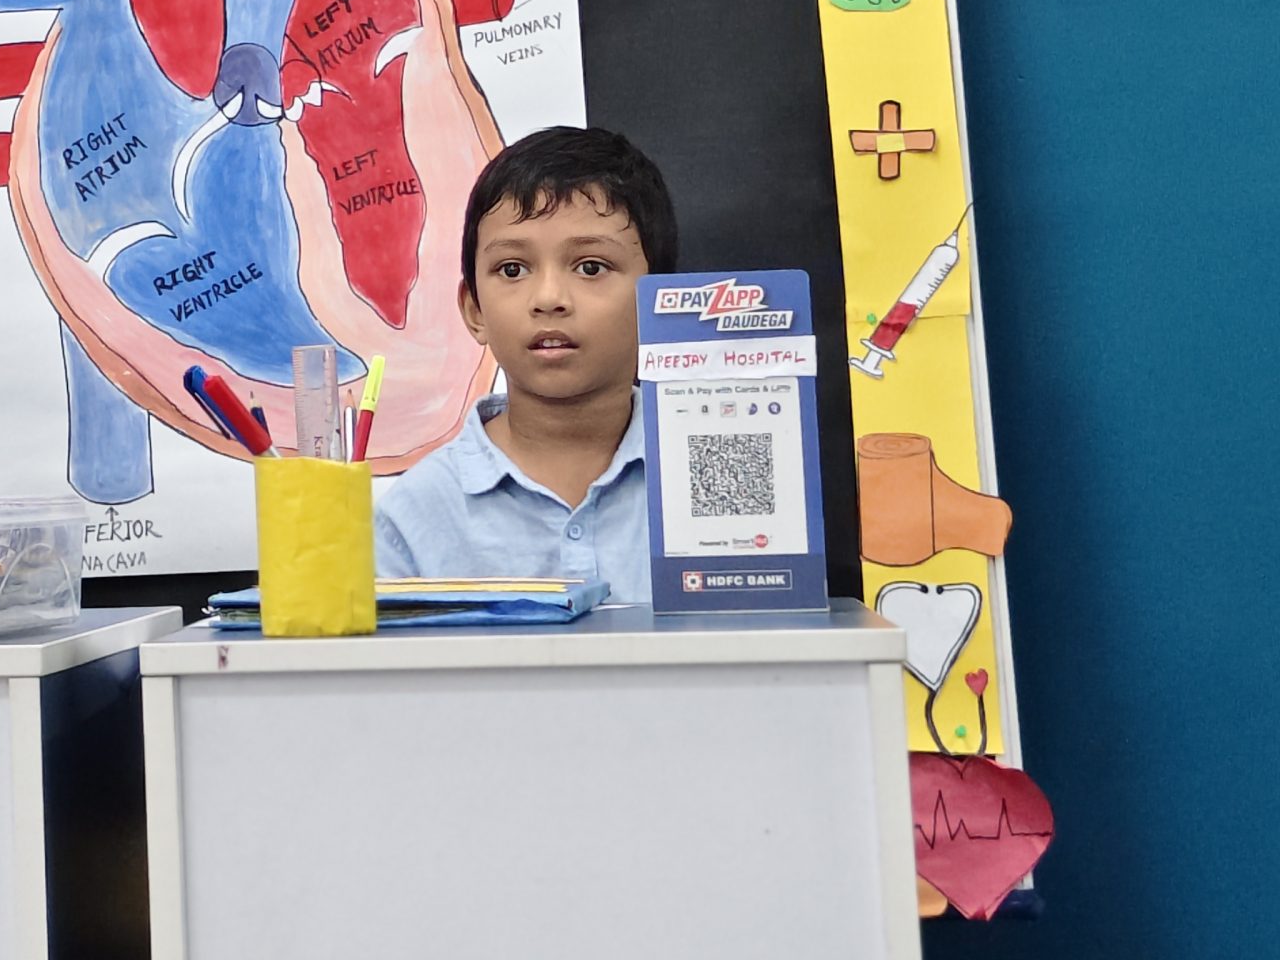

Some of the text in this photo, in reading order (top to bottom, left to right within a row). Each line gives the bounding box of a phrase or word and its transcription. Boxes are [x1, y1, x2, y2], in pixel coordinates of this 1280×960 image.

[317, 17, 382, 75] ATRIUM
[474, 12, 561, 48] PULMONARY
[497, 44, 543, 65] VEINS
[63, 112, 127, 170] RIGHT
[74, 135, 148, 202] ATRIUM
[333, 149, 378, 180] LEFT
[338, 178, 420, 215] VENTRICLE
[153, 251, 216, 296] RIGHT
[169, 262, 263, 322] VENTRICLE
[722, 313, 787, 329] DAUDEGA
[644, 350, 806, 370] APEEJAY HOSPITAL
[84, 520, 163, 544] FERIOR
[81, 551, 148, 574] NA CAVA
[706, 575, 786, 586] HDFC BANK
